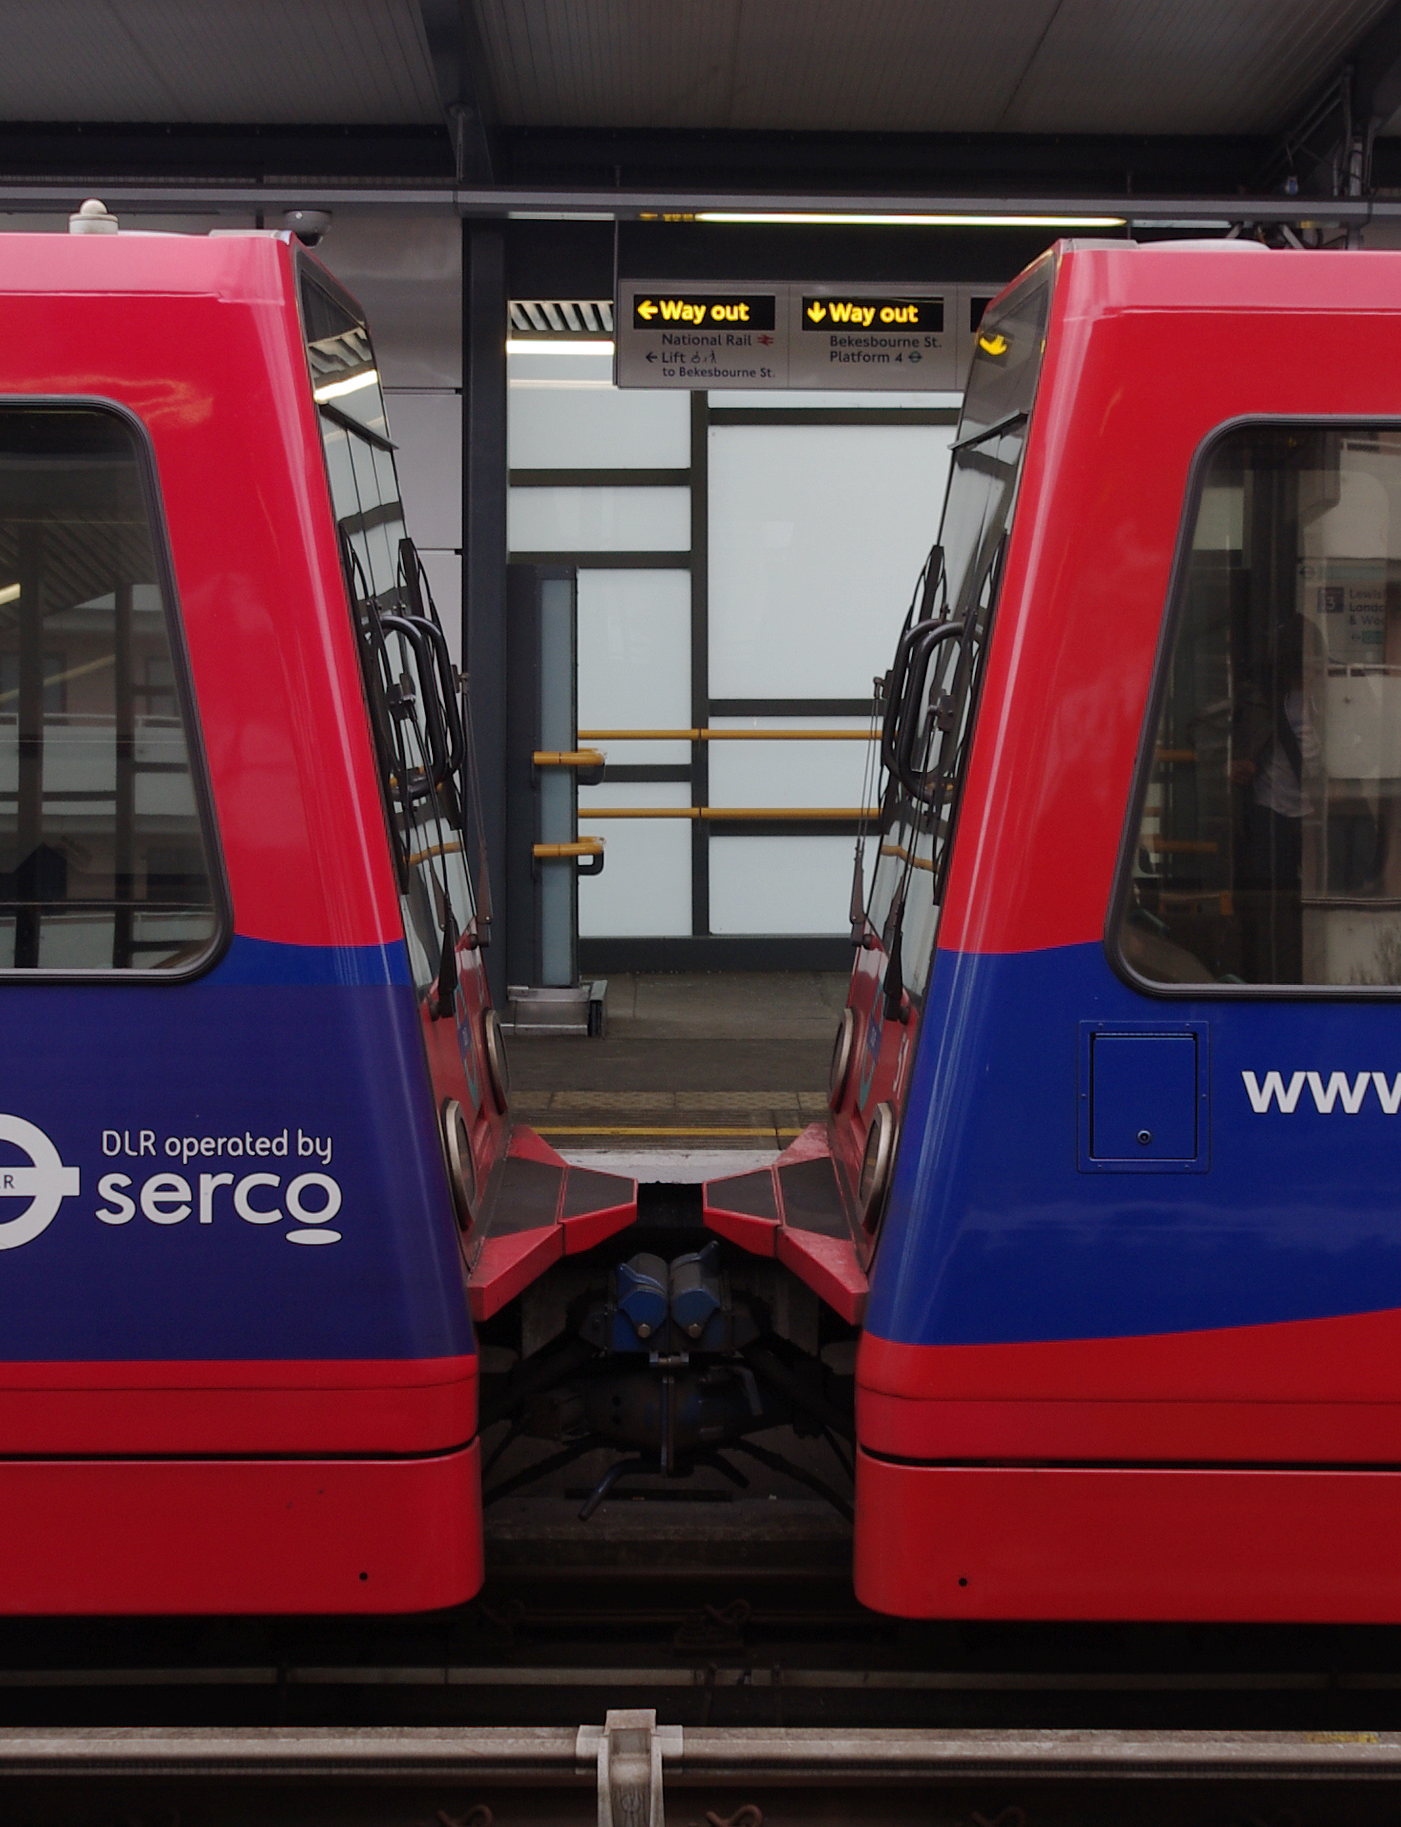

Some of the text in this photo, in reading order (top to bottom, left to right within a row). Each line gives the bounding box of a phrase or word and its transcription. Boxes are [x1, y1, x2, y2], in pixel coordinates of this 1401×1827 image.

[659, 300, 750, 325] Way out
[828, 302, 919, 327] Way out
[662, 334, 752, 346] National Rail
[830, 336, 942, 348] Bekesbourne St.
[662, 352, 686, 363] Lift
[830, 351, 902, 363] Platform 4
[663, 367, 776, 378] to Bekesbourne St.
[1349, 589, 1385, 599] Lewis
[102, 1128, 333, 1165] DLR operated by
[95, 1172, 343, 1226] serco
